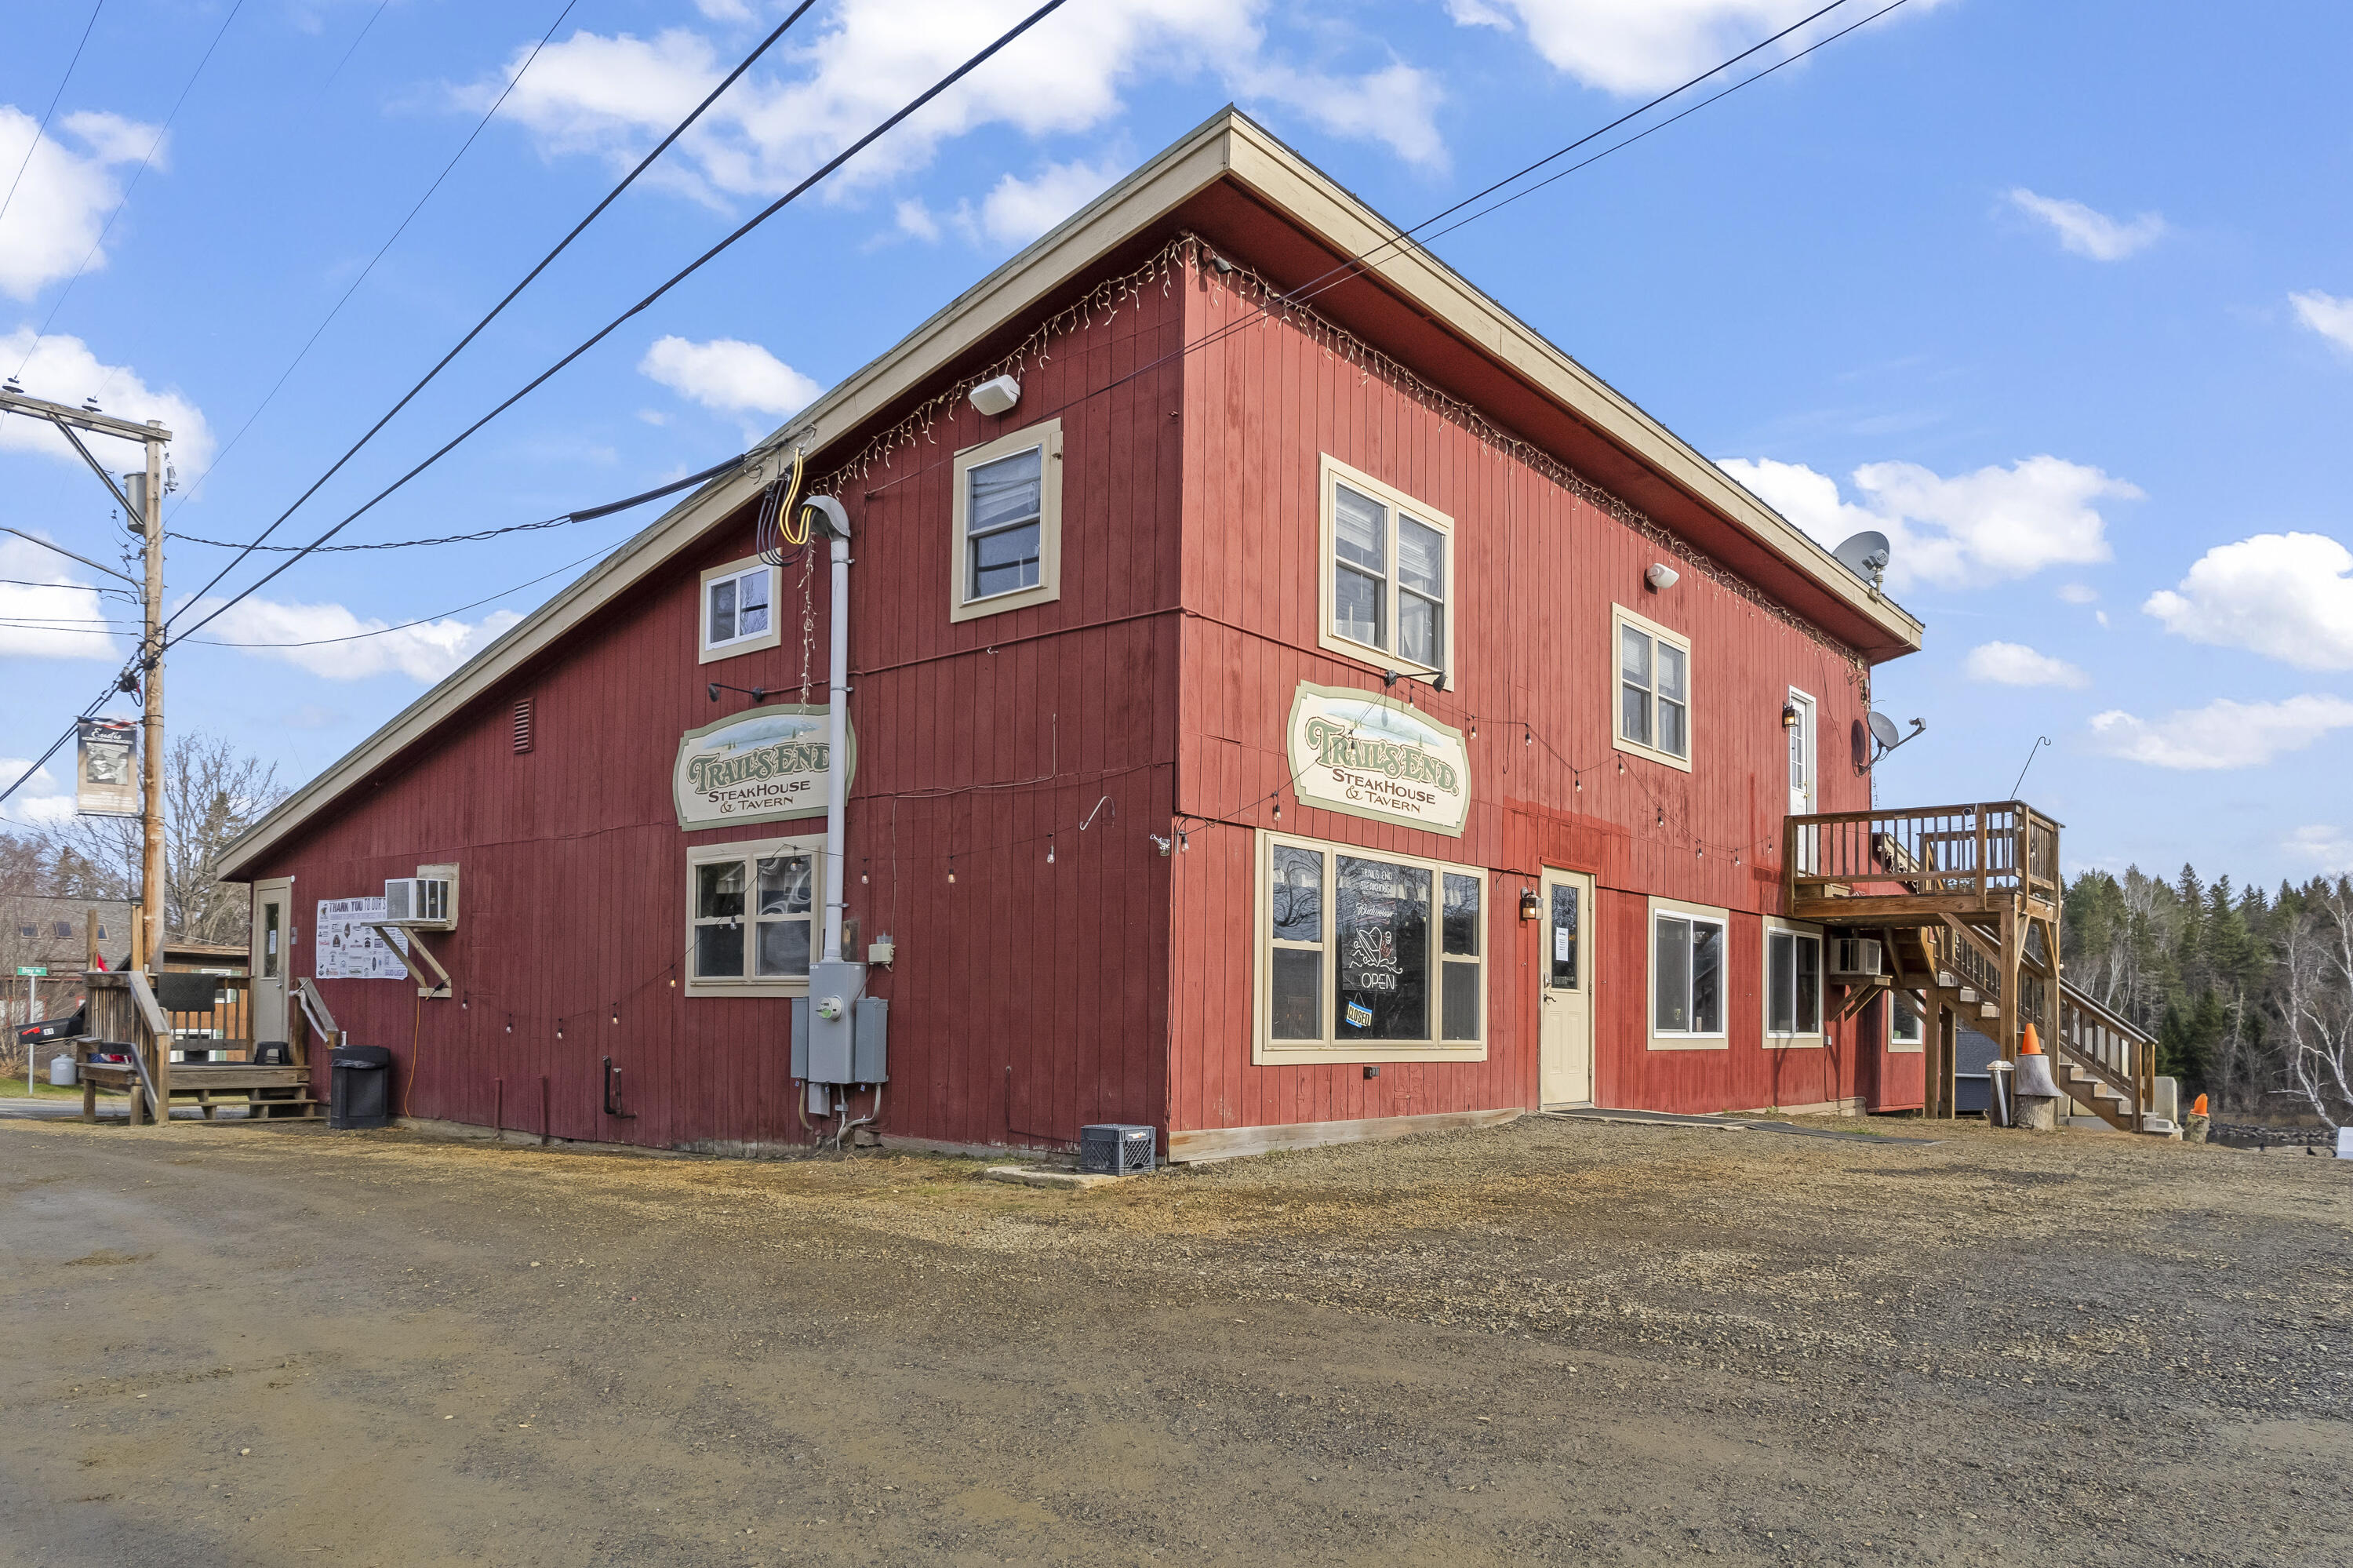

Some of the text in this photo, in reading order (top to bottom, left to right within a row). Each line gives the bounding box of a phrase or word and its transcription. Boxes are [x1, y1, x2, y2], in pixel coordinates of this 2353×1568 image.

[1305, 716, 1402, 779] TRAIL'S
[687, 748, 773, 794] TRAIL'S
[708, 780, 811, 803] STEAKHOUSE
[1333, 768, 1436, 805] STEAKHOUSE
[720, 796, 794, 814] & TAVERN
[1346, 785, 1420, 814] & TAVERN
[329, 902, 349, 913] THANK
[351, 900, 363, 911] YOU
[364, 898, 371, 911] TO
[1361, 973, 1395, 990] OPEN
[1347, 1006, 1370, 1025] CLOSED
